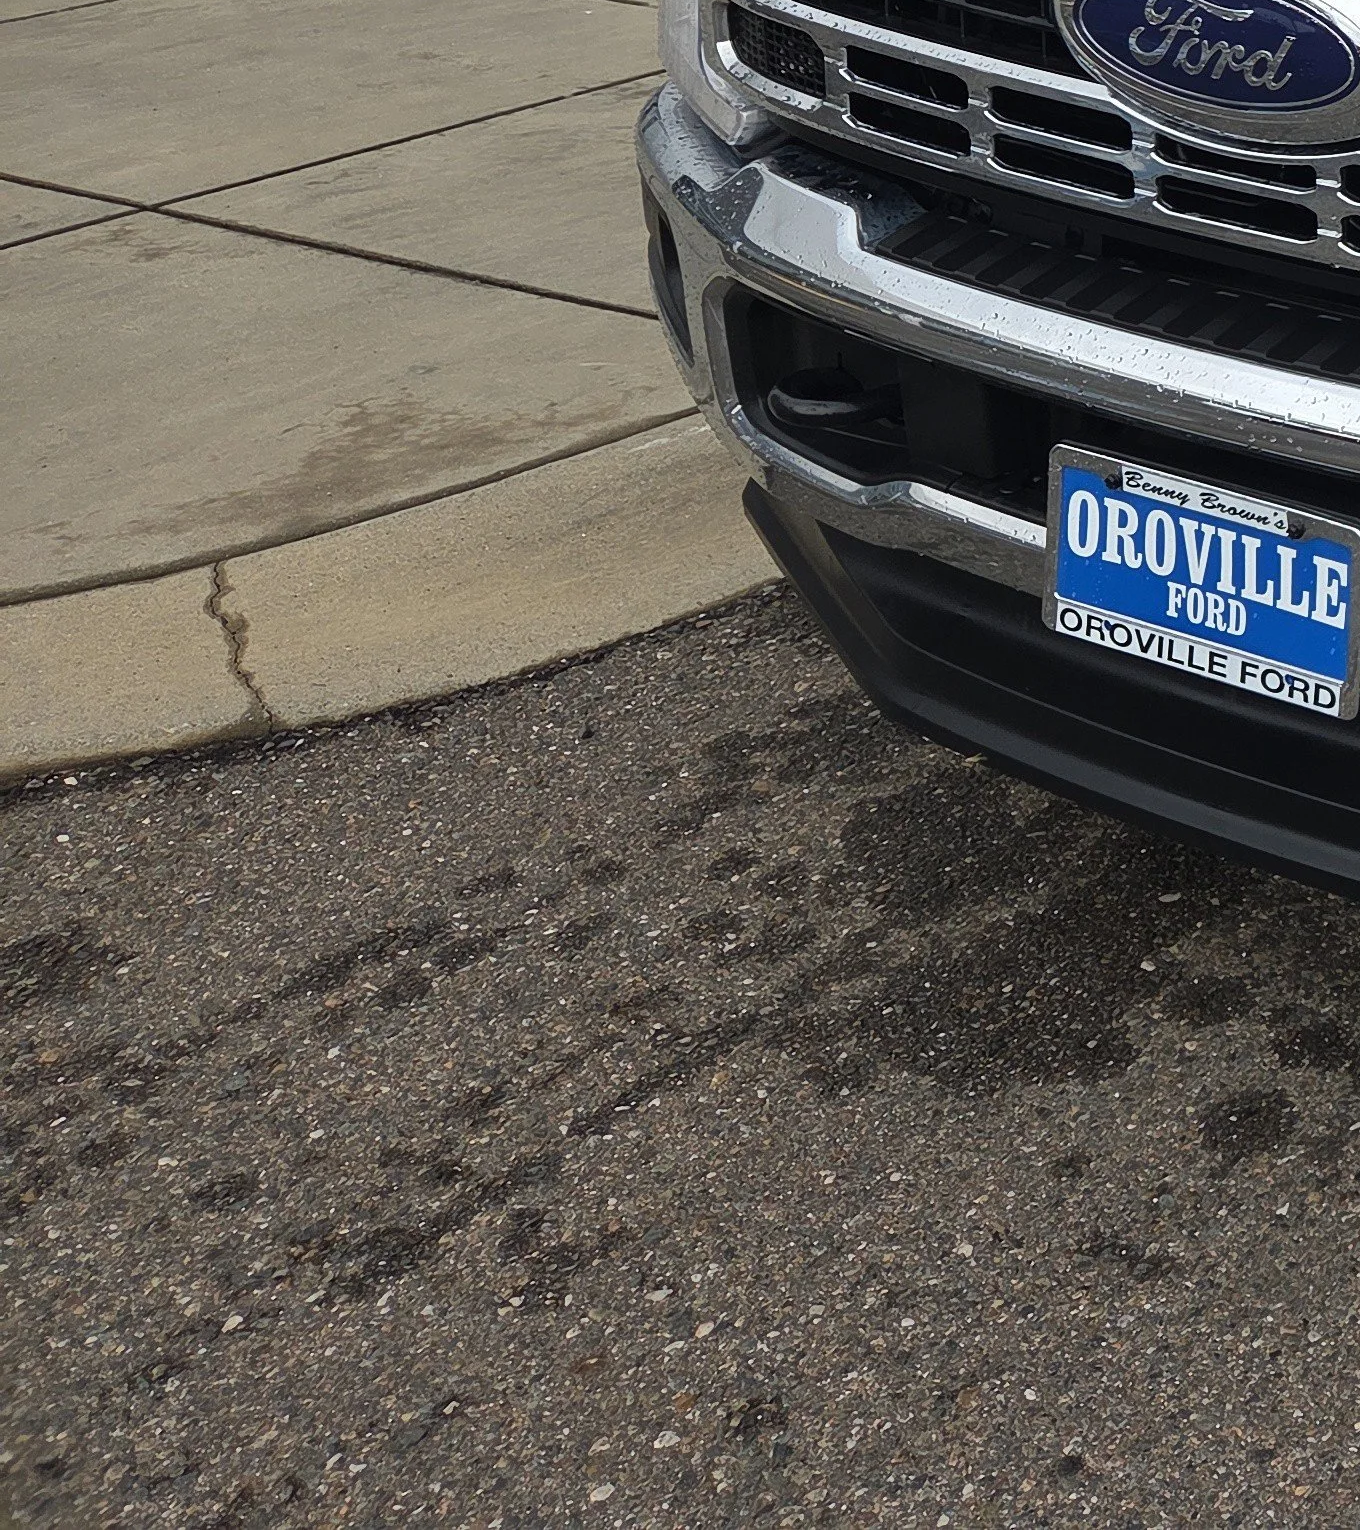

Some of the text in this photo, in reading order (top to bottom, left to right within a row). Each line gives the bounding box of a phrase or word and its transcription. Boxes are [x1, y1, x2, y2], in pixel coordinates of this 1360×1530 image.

[1124, 470, 1287, 530] Benny Brown's
[1067, 490, 1348, 630] OROVILLE
[1166, 581, 1247, 636] FORD
[1058, 607, 1337, 710] OROVILLE FORD
